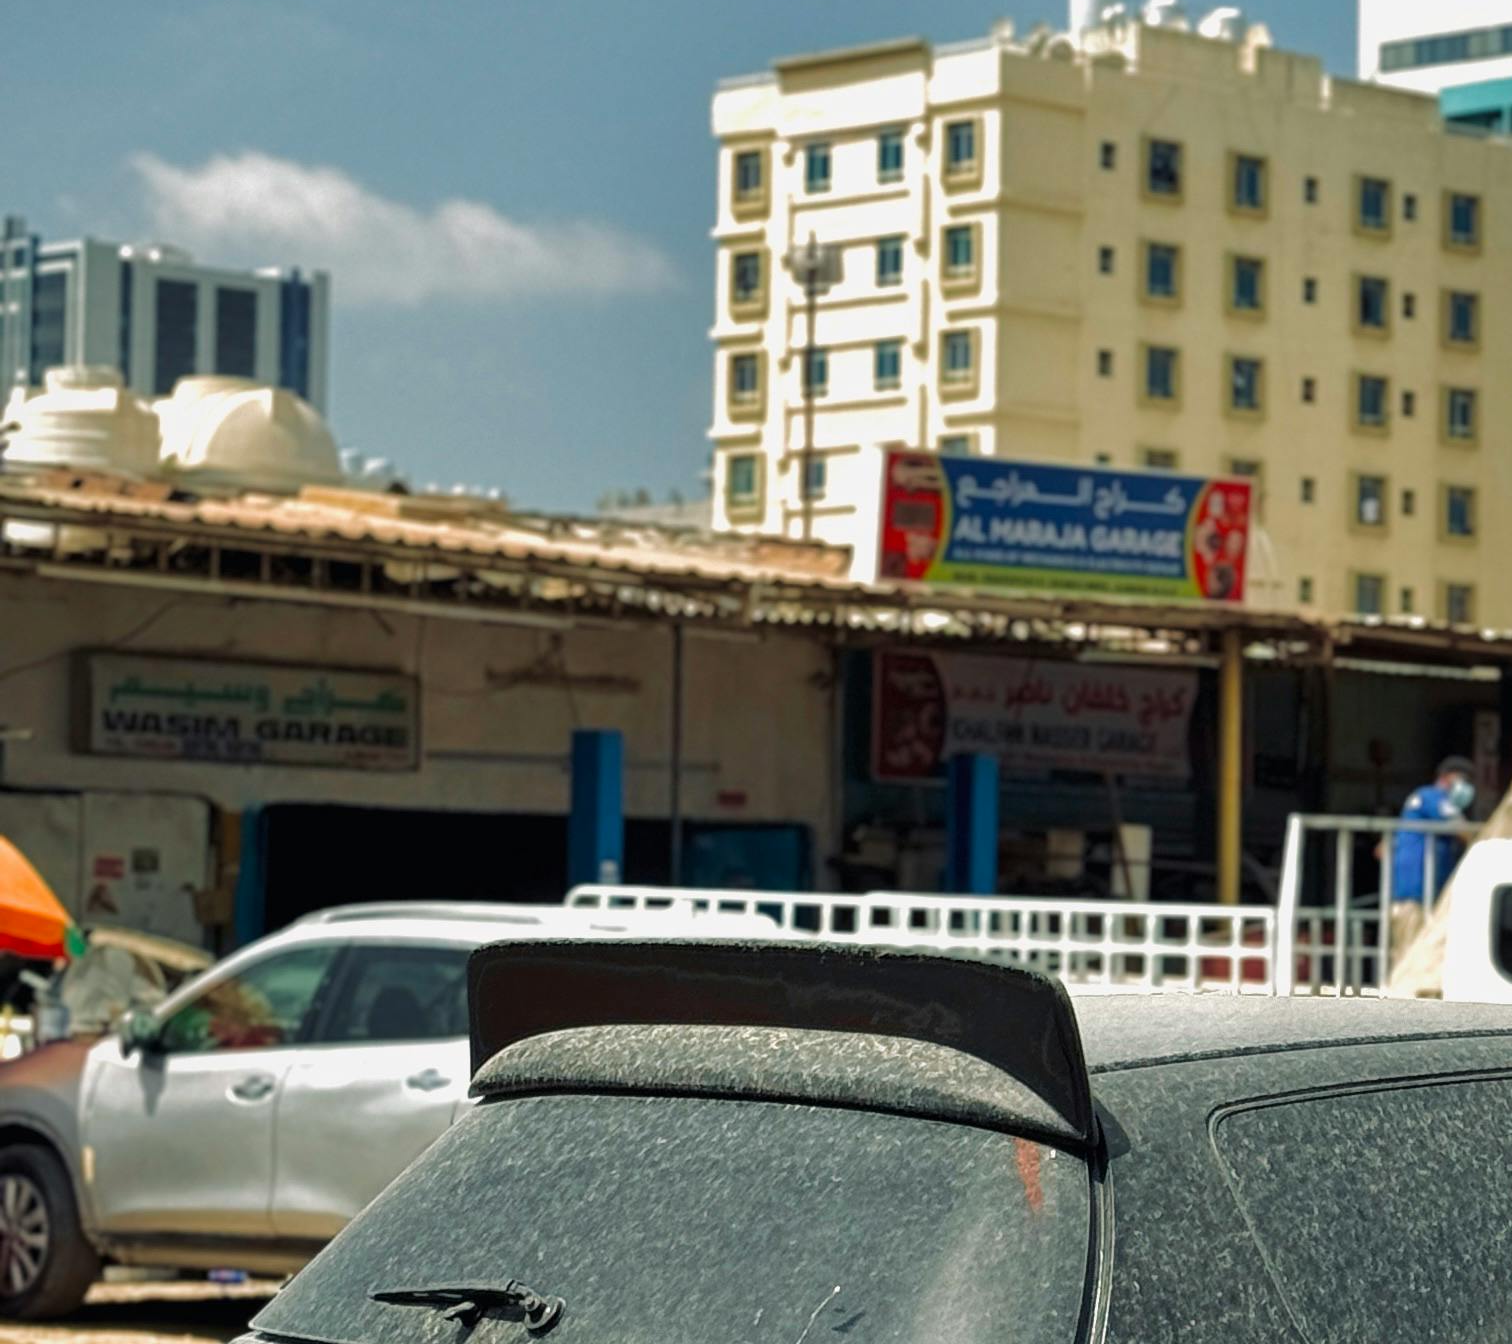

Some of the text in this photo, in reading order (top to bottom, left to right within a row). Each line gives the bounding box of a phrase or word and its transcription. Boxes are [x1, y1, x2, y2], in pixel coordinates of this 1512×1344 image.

[954, 514, 987, 544] AL
[1090, 524, 1183, 558] GARAGE
[102, 709, 409, 748] WASIM GARAGE
